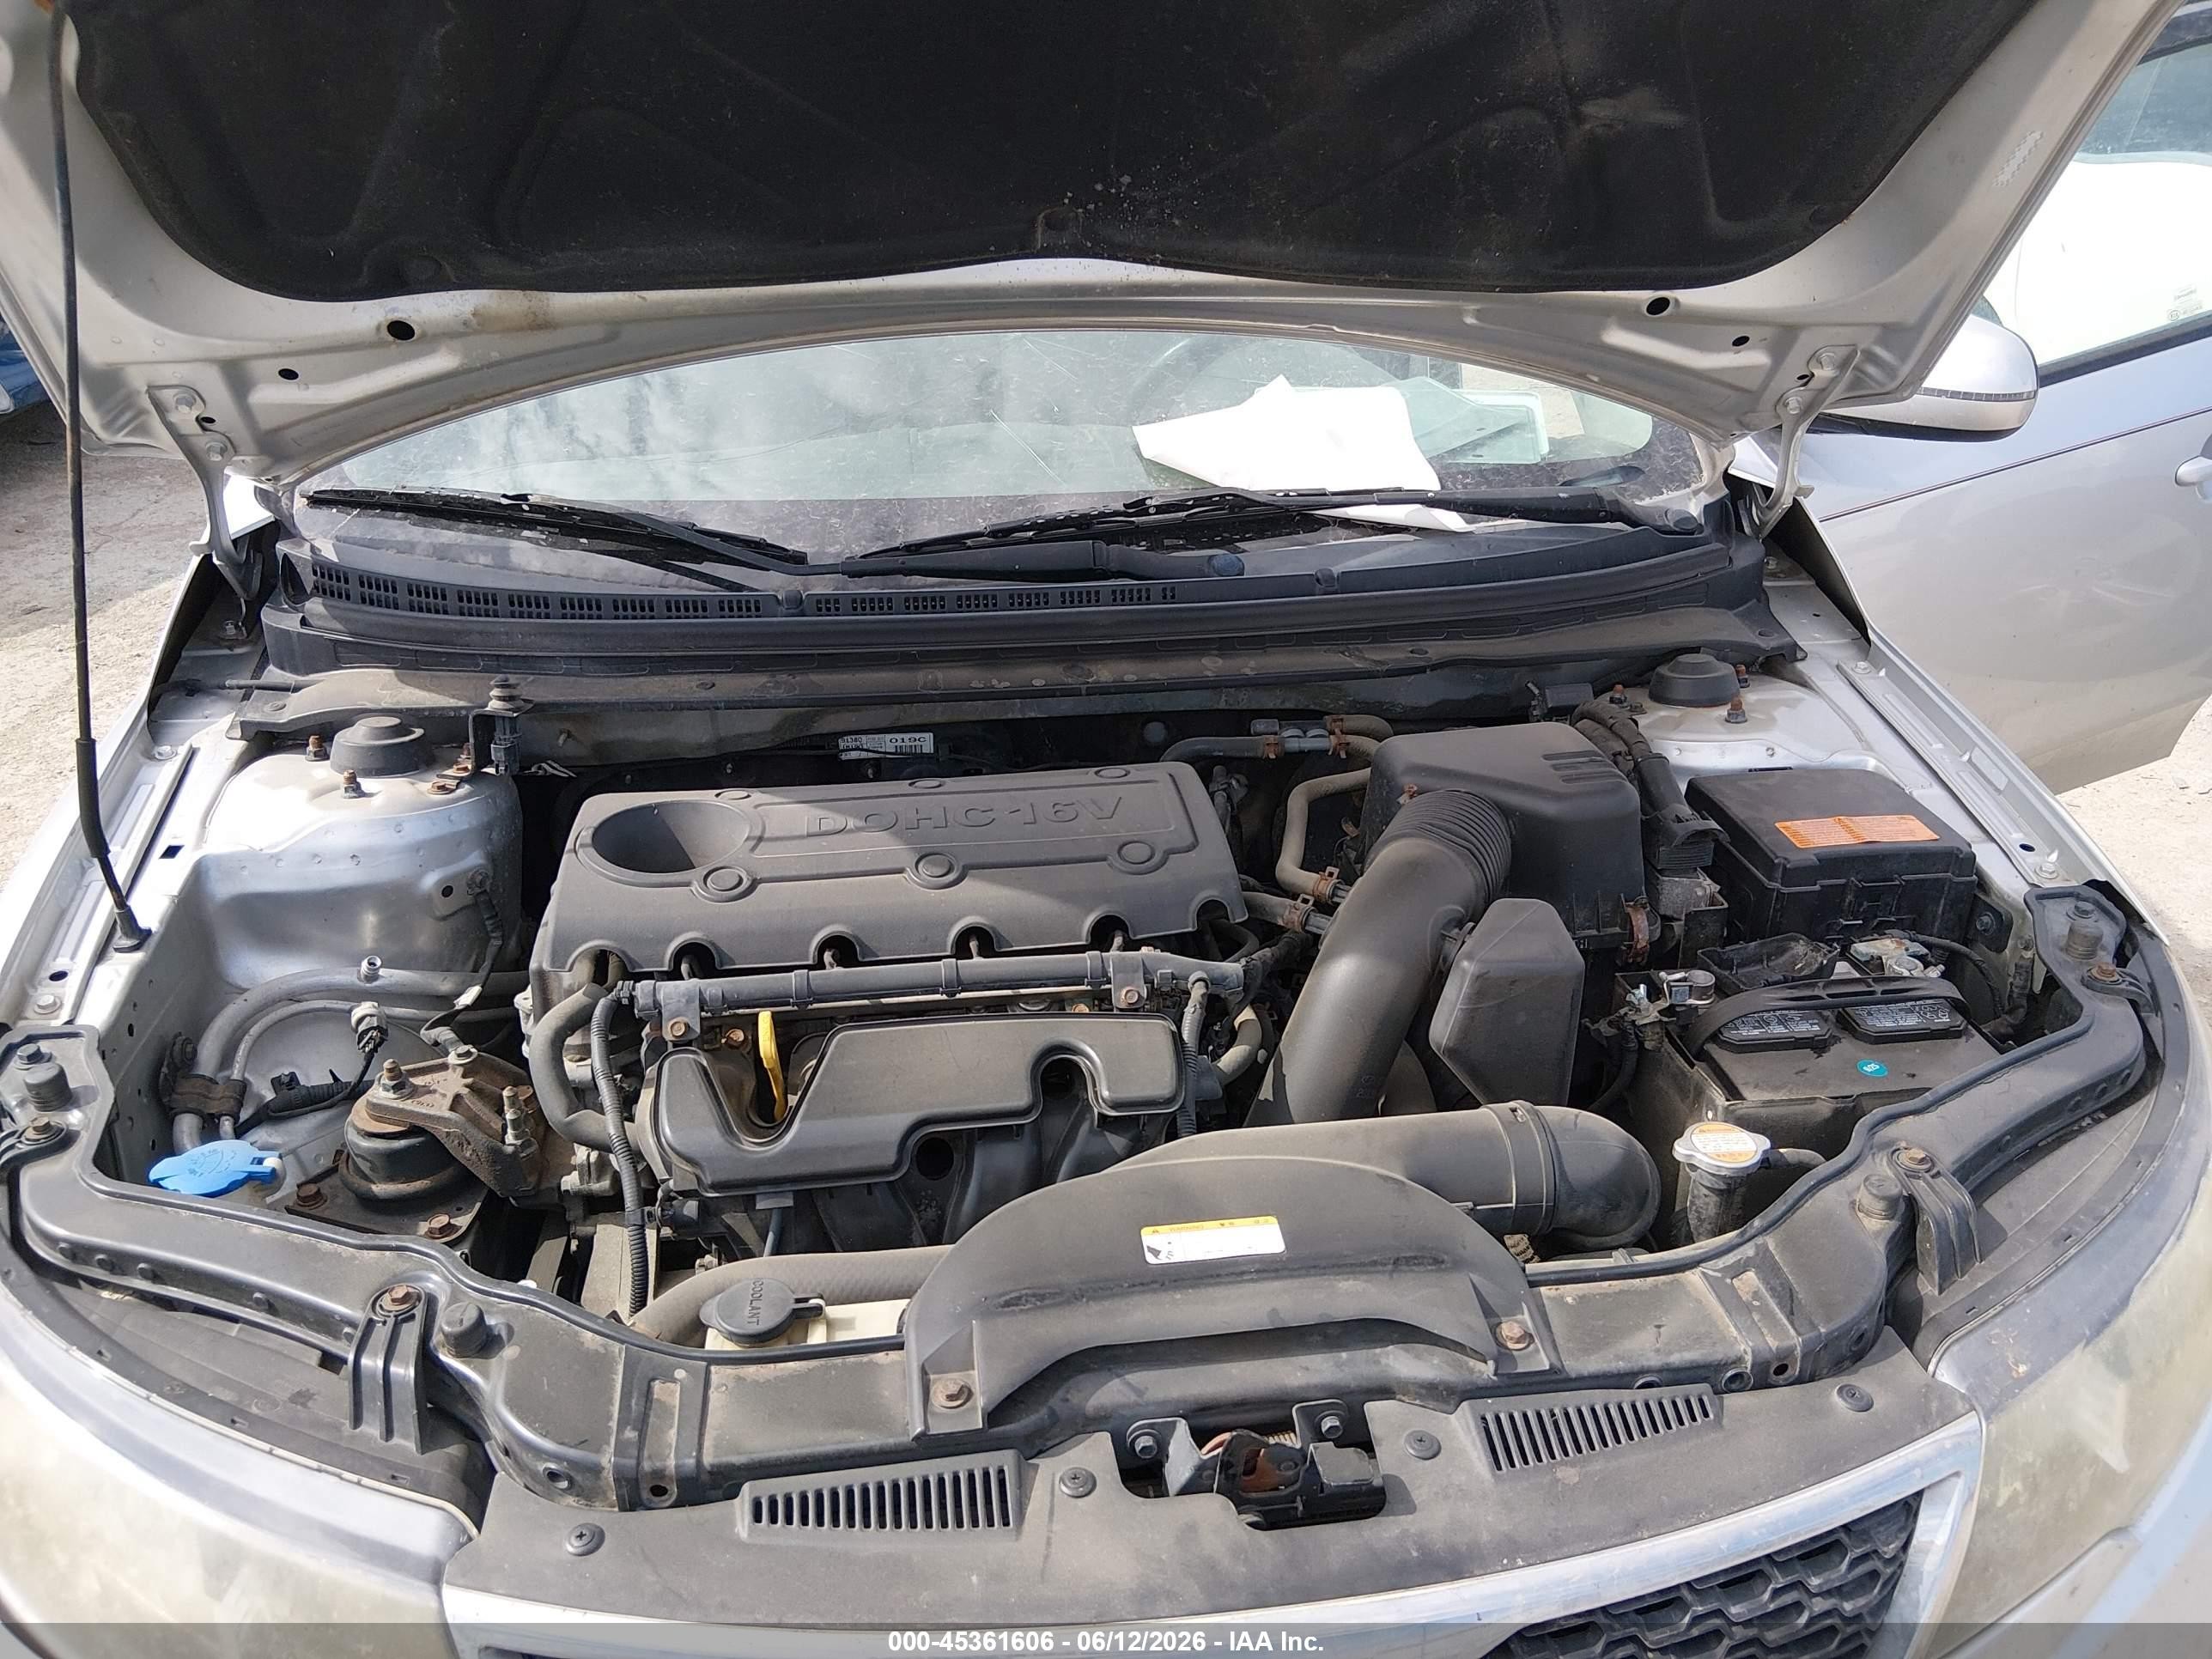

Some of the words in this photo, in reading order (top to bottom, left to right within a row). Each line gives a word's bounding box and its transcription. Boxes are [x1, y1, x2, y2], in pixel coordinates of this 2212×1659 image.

[805, 805, 997, 839] DOHC
[1007, 795, 1122, 825] 16V
[747, 1279, 764, 1326] COOLANT
